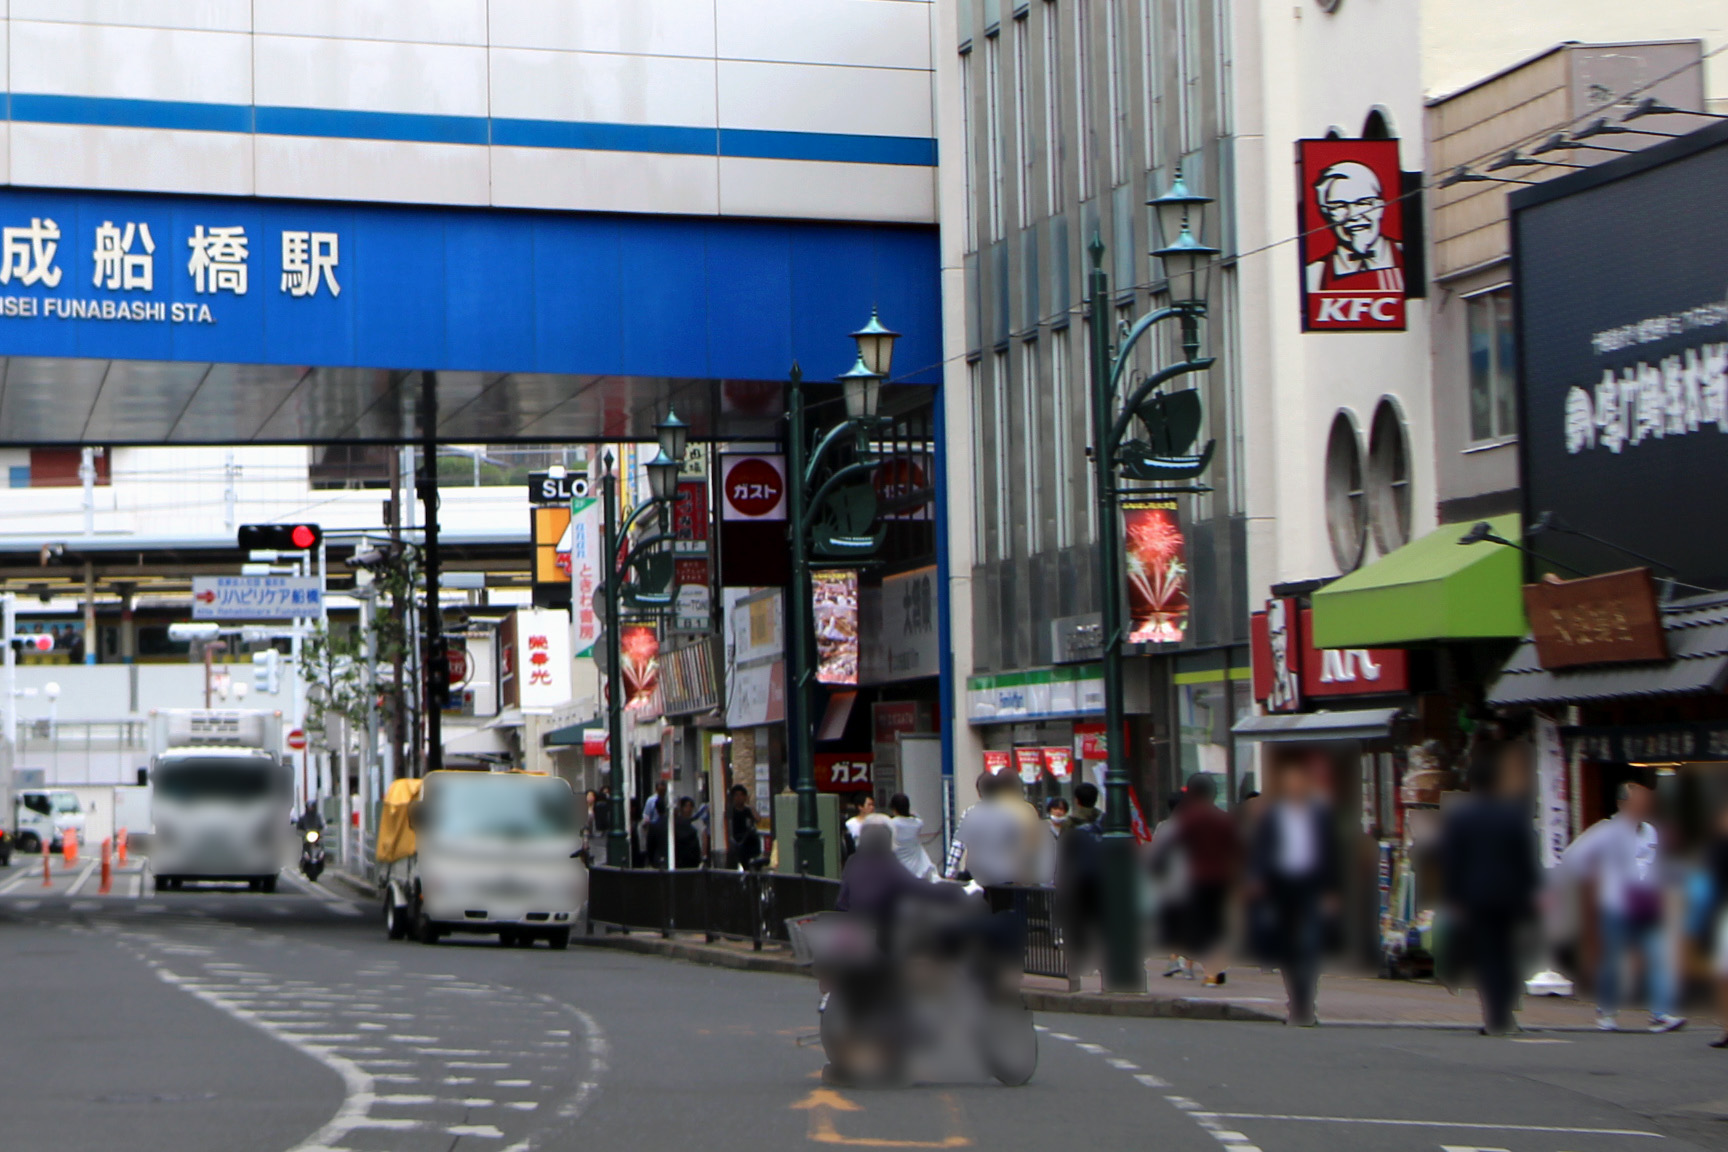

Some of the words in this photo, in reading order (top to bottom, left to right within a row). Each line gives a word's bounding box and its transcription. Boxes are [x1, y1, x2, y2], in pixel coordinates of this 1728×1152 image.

[43, 299, 166, 321] FUNABASHI
[170, 304, 216, 323] STA.
[1316, 297, 1398, 322] KFC
[733, 484, 777, 500] ガスト
